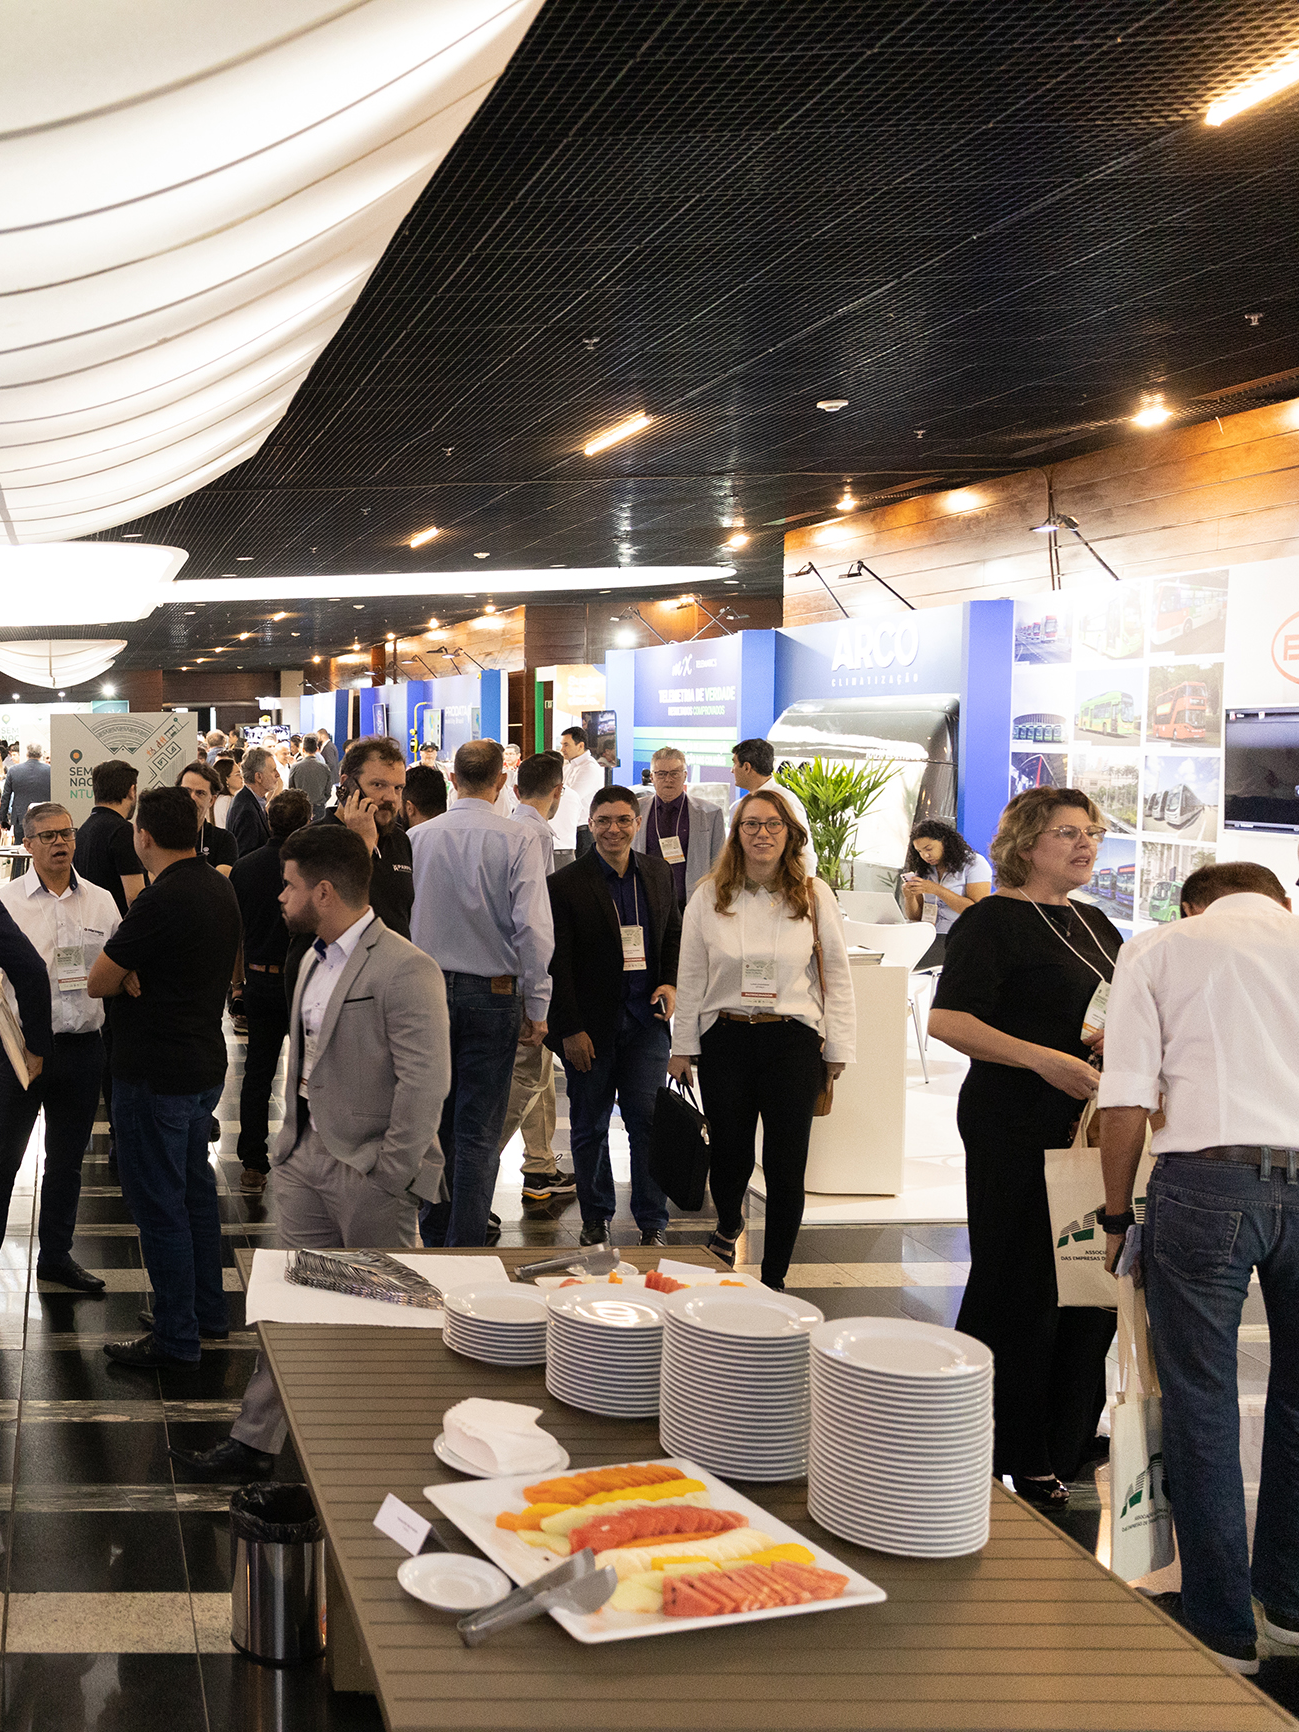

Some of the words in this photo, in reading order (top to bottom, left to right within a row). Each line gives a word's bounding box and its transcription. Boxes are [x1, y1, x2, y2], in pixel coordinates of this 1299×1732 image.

[831, 618, 919, 672] ARCO
[831, 672, 919, 687] CLIMATIZAÇÃO
[658, 688, 694, 703] TELEMETRIA
[696, 688, 704, 702] DE
[705, 685, 736, 702] VERDADE
[693, 705, 726, 716] COMPROVADOS
[70, 789, 94, 799] NTU
